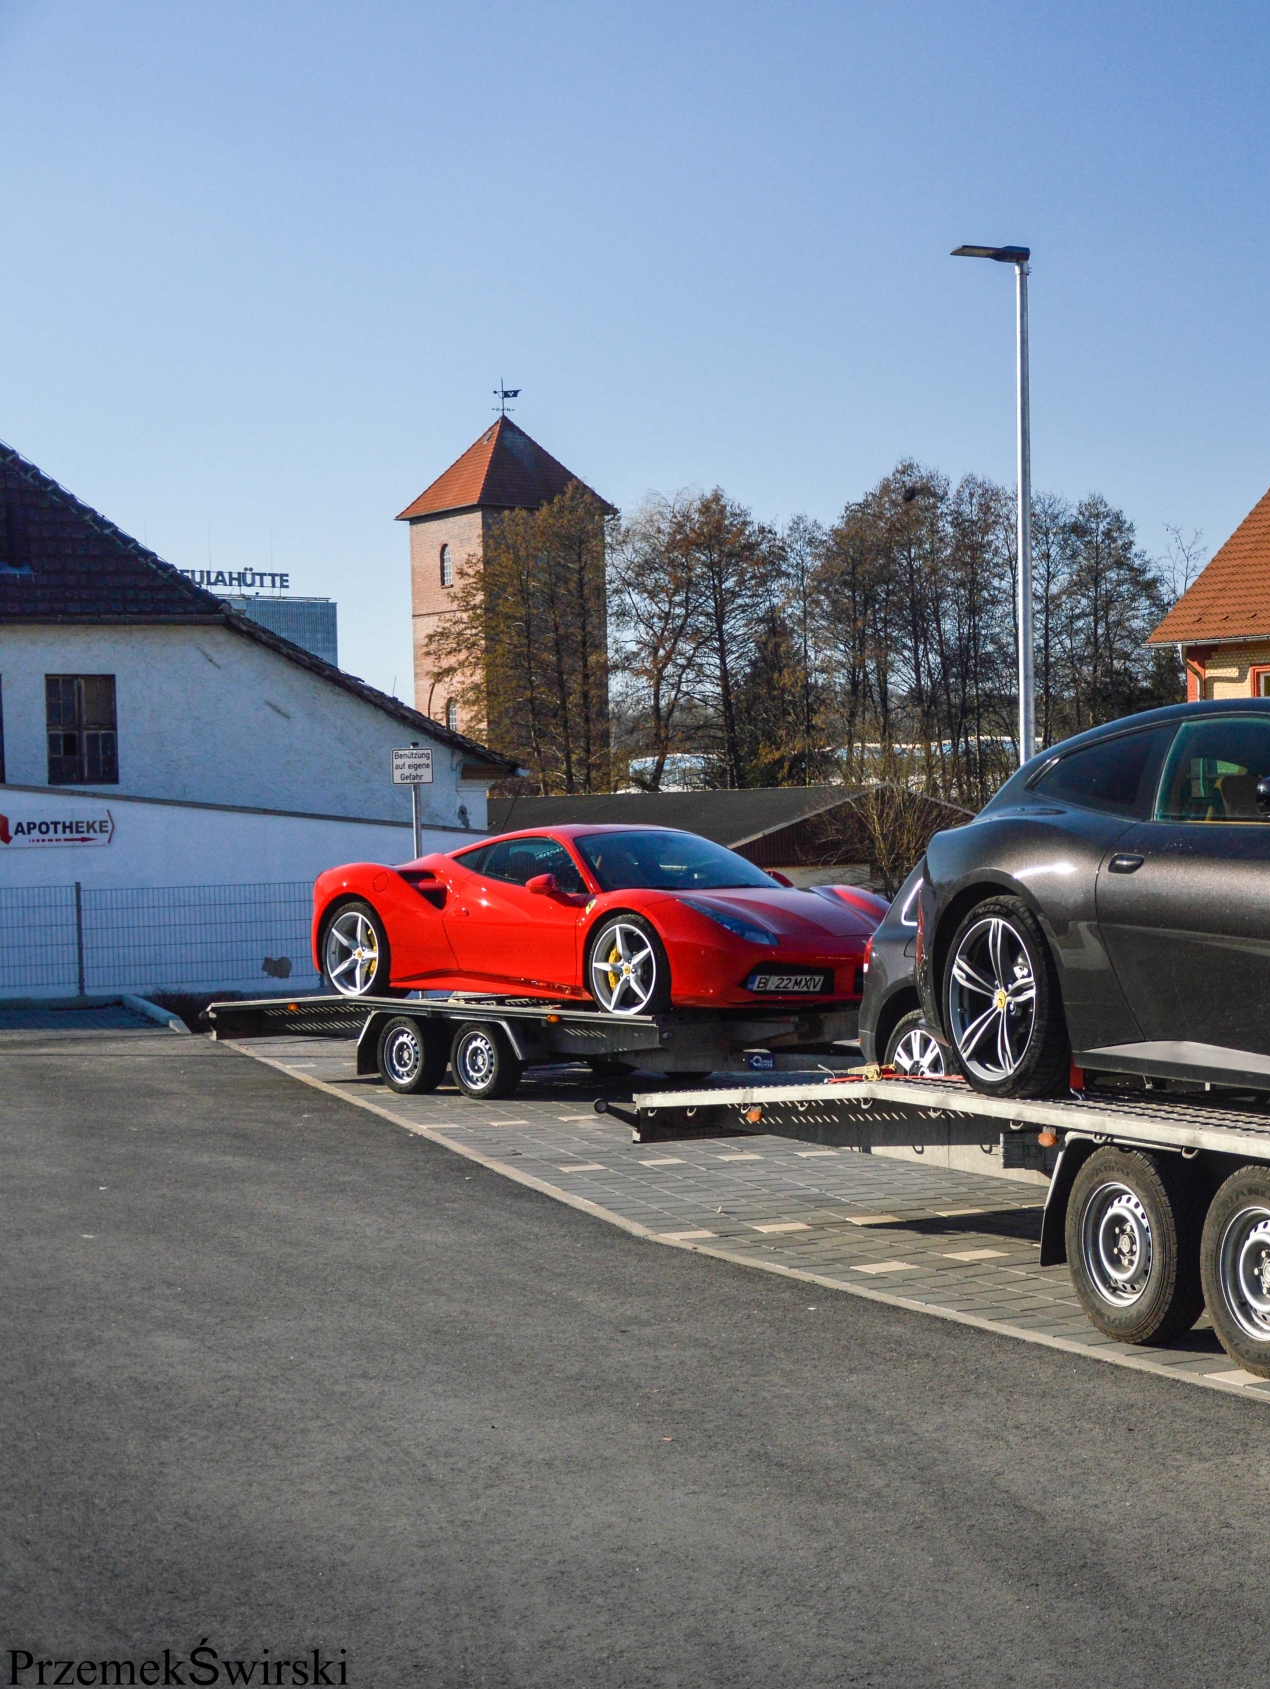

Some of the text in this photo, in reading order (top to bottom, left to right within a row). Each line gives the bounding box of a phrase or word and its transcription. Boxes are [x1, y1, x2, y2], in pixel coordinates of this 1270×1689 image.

[394, 762, 430, 771] auf eigene
[400, 773, 424, 781] Gefahr
[14, 820, 109, 836] APOTHEKE
[756, 977, 768, 989] B
[774, 977, 792, 989] 22
